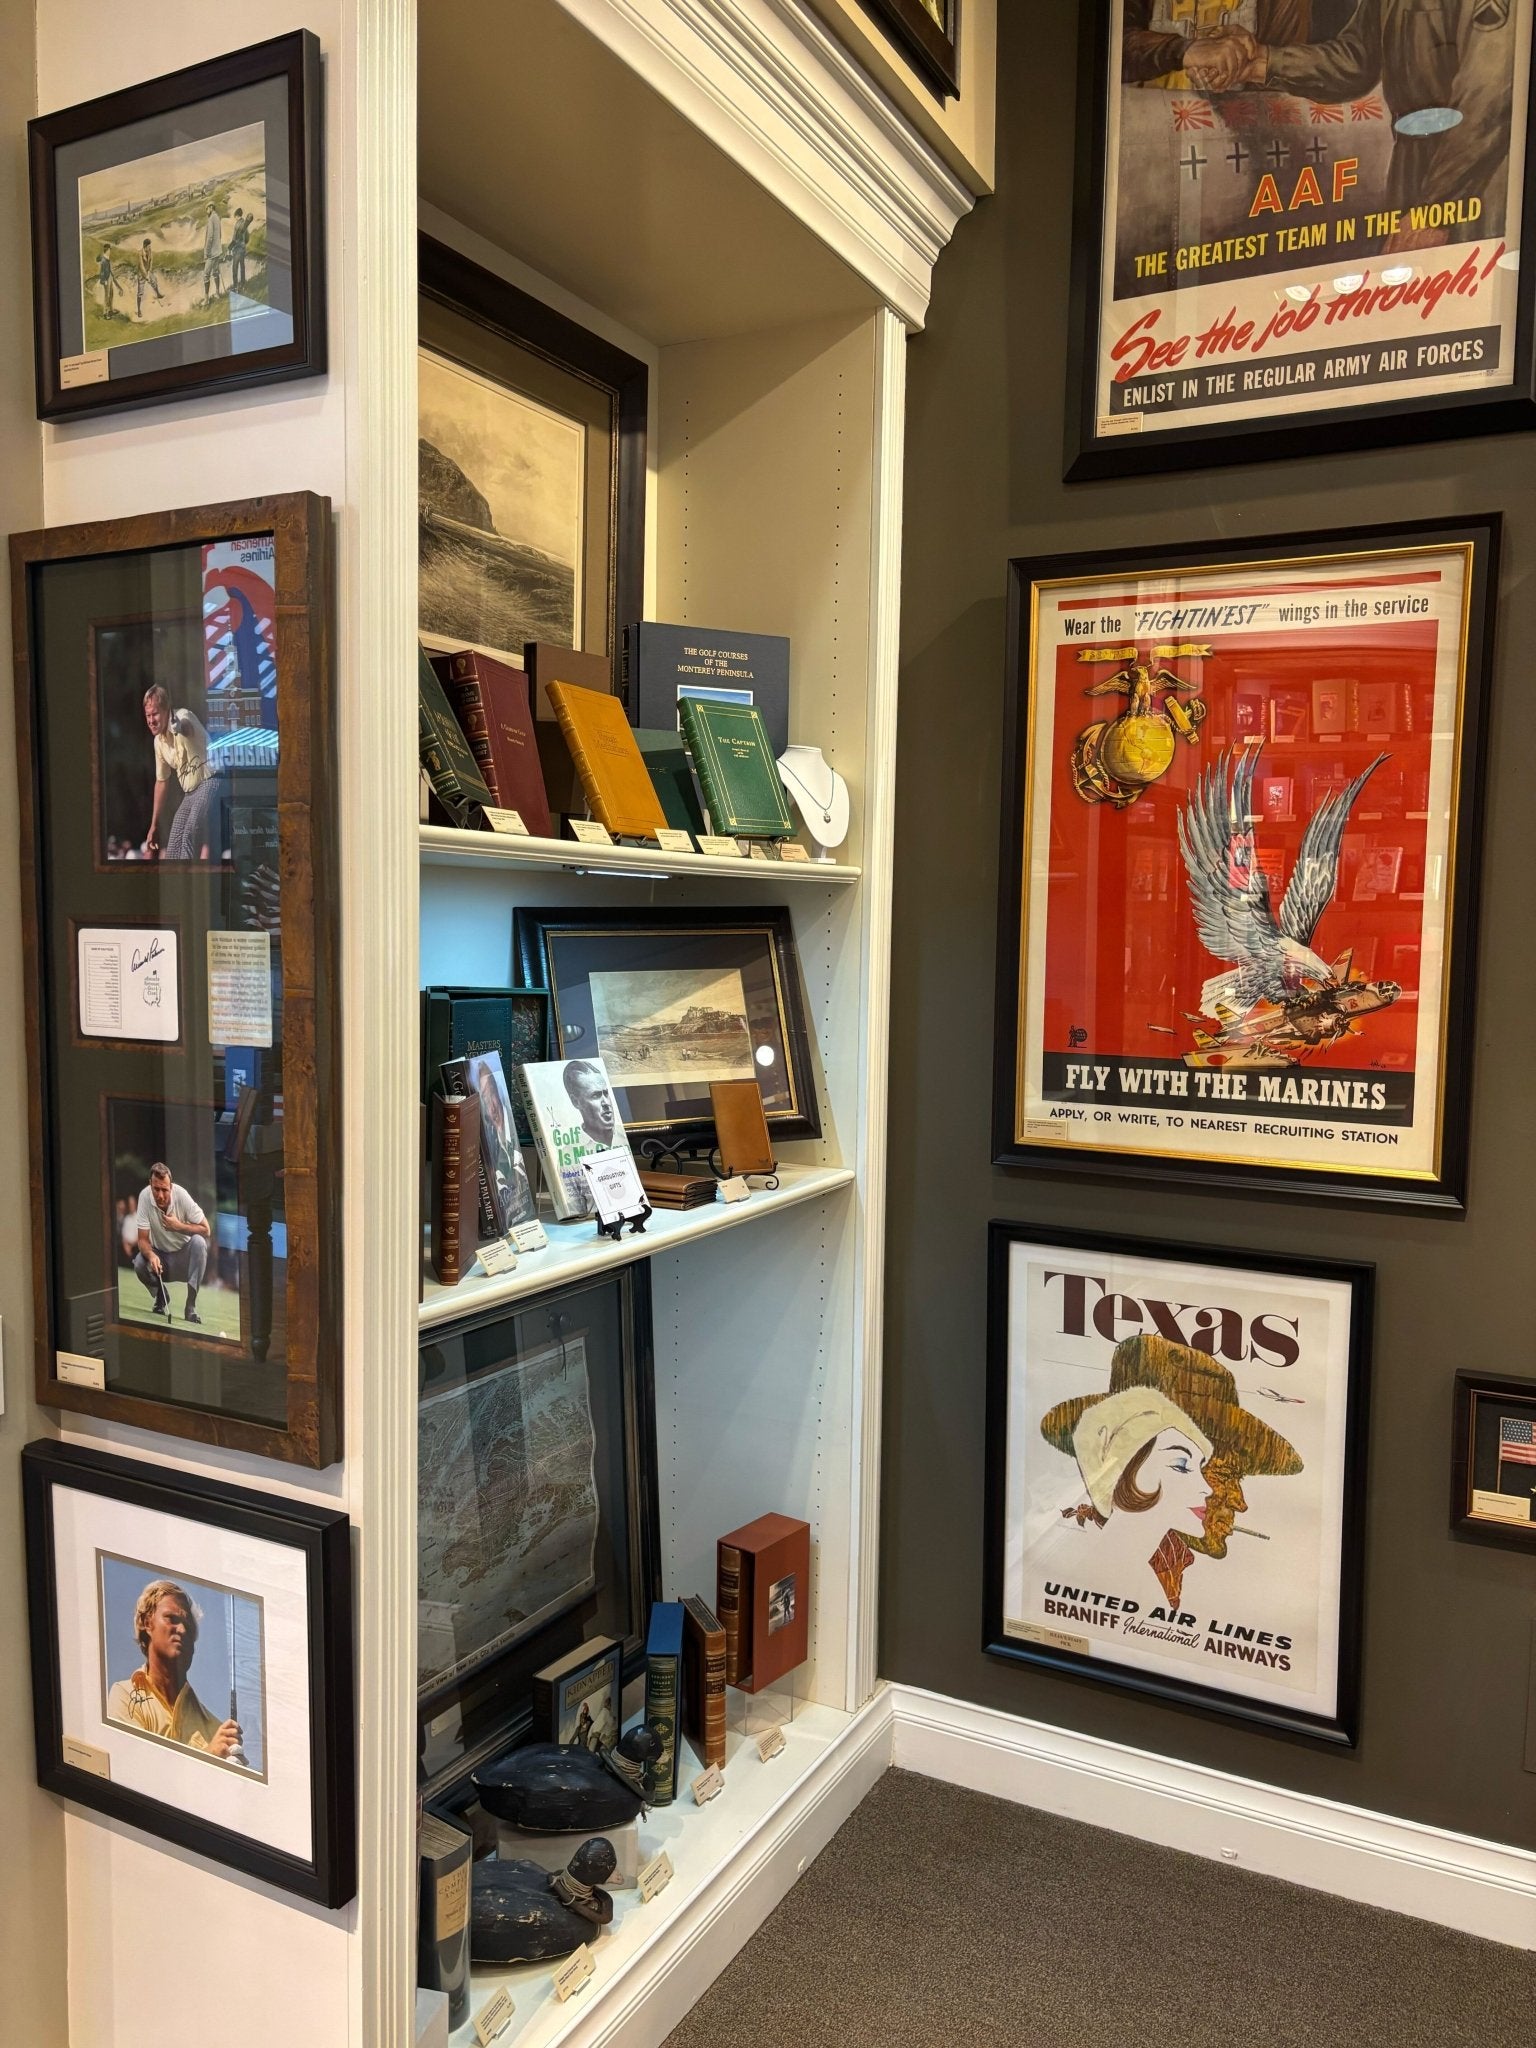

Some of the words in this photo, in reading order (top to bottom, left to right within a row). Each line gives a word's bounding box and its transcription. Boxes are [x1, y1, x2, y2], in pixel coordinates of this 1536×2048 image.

[1249, 158, 1358, 217] AAF
[1134, 251, 1168, 278] THE
[1175, 233, 1269, 270] GREATEST
[1276, 223, 1327, 253] TEAM
[1336, 218, 1356, 243] IN
[1364, 210, 1402, 238] THE
[1410, 197, 1482, 231] WORLD
[1110, 308, 1191, 384] See
[1194, 306, 1256, 359] the
[1251, 284, 1321, 352] job
[1324, 241, 1506, 325] through!
[1123, 382, 1175, 407] ENLIST
[1182, 378, 1199, 399] IN
[1206, 373, 1236, 396] THE
[1243, 362, 1316, 391] REGULAR
[1323, 353, 1372, 379] ARMY
[1378, 349, 1408, 371] AIR
[1416, 339, 1484, 366] FORCES
[1064, 617, 1096, 636] Wear
[1100, 615, 1122, 633] the
[1278, 603, 1320, 624] wings
[1325, 601, 1338, 618] in
[1344, 598, 1368, 617] the
[1373, 595, 1429, 615] service
[677, 665, 716, 675] MONTEREY
[716, 668, 754, 679] PENINSULA
[683, 647, 698, 656] THE
[698, 649, 717, 658] GOLF
[717, 651, 748, 661] COURSES
[704, 658, 714, 666] OF
[714, 659, 728, 668] THE
[467, 1040, 501, 1051] MASTERS
[1066, 1064, 1111, 1091] FLY
[1119, 1067, 1189, 1097] WITH
[1194, 1072, 1247, 1100] THE
[1258, 1076, 1386, 1110] MARINES
[552, 1126, 581, 1146] Golf
[1050, 1108, 1088, 1122] APPLY,
[1093, 1111, 1112, 1122] OR
[1118, 1113, 1160, 1127] WRITE,
[1166, 1116, 1184, 1127] TO
[1190, 1119, 1247, 1132] NEAREST
[1254, 1123, 1335, 1139] RECRUITING
[1341, 1130, 1398, 1144] STATION
[558, 1149, 572, 1167] Is
[597, 1170, 626, 1182] GRADUATION
[480, 1185, 494, 1221] PALMER
[609, 1182, 622, 1190] GIFTS
[1044, 1271, 1300, 1368] Texas
[1044, 1582, 1140, 1614] UNITED
[1148, 1606, 1198, 1628] AIR
[1208, 1619, 1293, 1650] LINES
[1044, 1598, 1121, 1629] BRANIFF
[1123, 1616, 1201, 1649] International
[1203, 1637, 1292, 1672] AIRWAYS
[567, 1662, 614, 1698] KIDNAPPED
